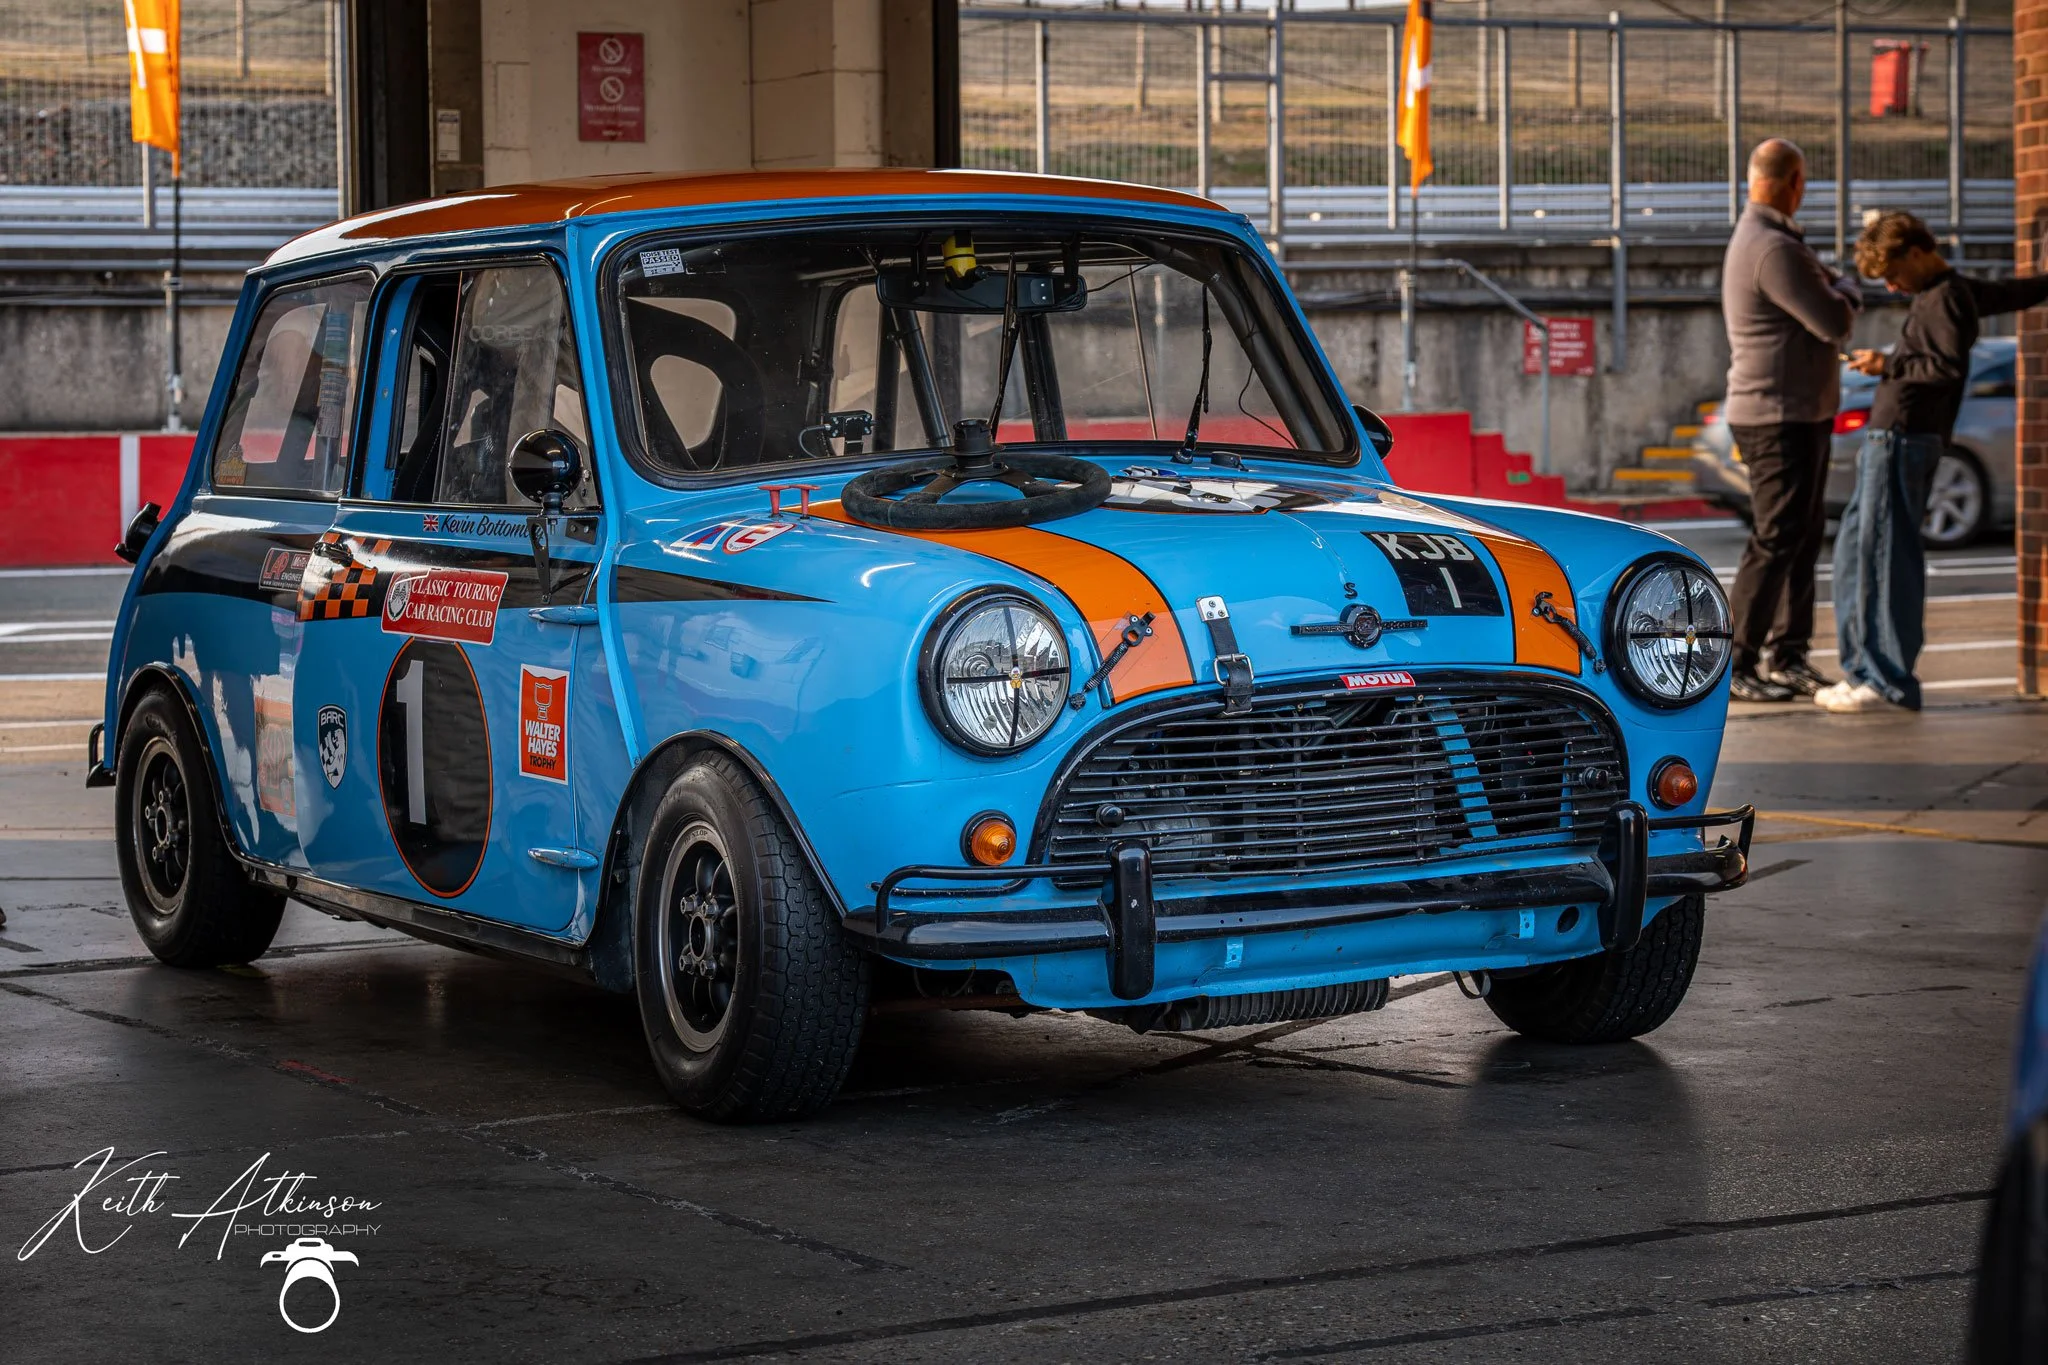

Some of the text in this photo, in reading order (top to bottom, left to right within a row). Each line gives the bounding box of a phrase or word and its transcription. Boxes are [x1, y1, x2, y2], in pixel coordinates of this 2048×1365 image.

[643, 255, 678, 264] PASSED
[469, 325, 546, 342] CORBEA
[441, 514, 473, 535] Kevin
[1371, 533, 1475, 561] KJB
[281, 572, 303, 582] ENGINEE
[411, 578, 500, 602] CLASSIC TOURING
[1343, 582, 1358, 599] S
[406, 602, 494, 628] CAR RACING CLUB
[1346, 672, 1411, 688] MOTUL
[320, 711, 345, 727] BARC
[525, 719, 561, 742] WALTER
[396, 659, 427, 825] 1
[528, 737, 557, 758] HAYES
[529, 755, 556, 771] TROPHY
